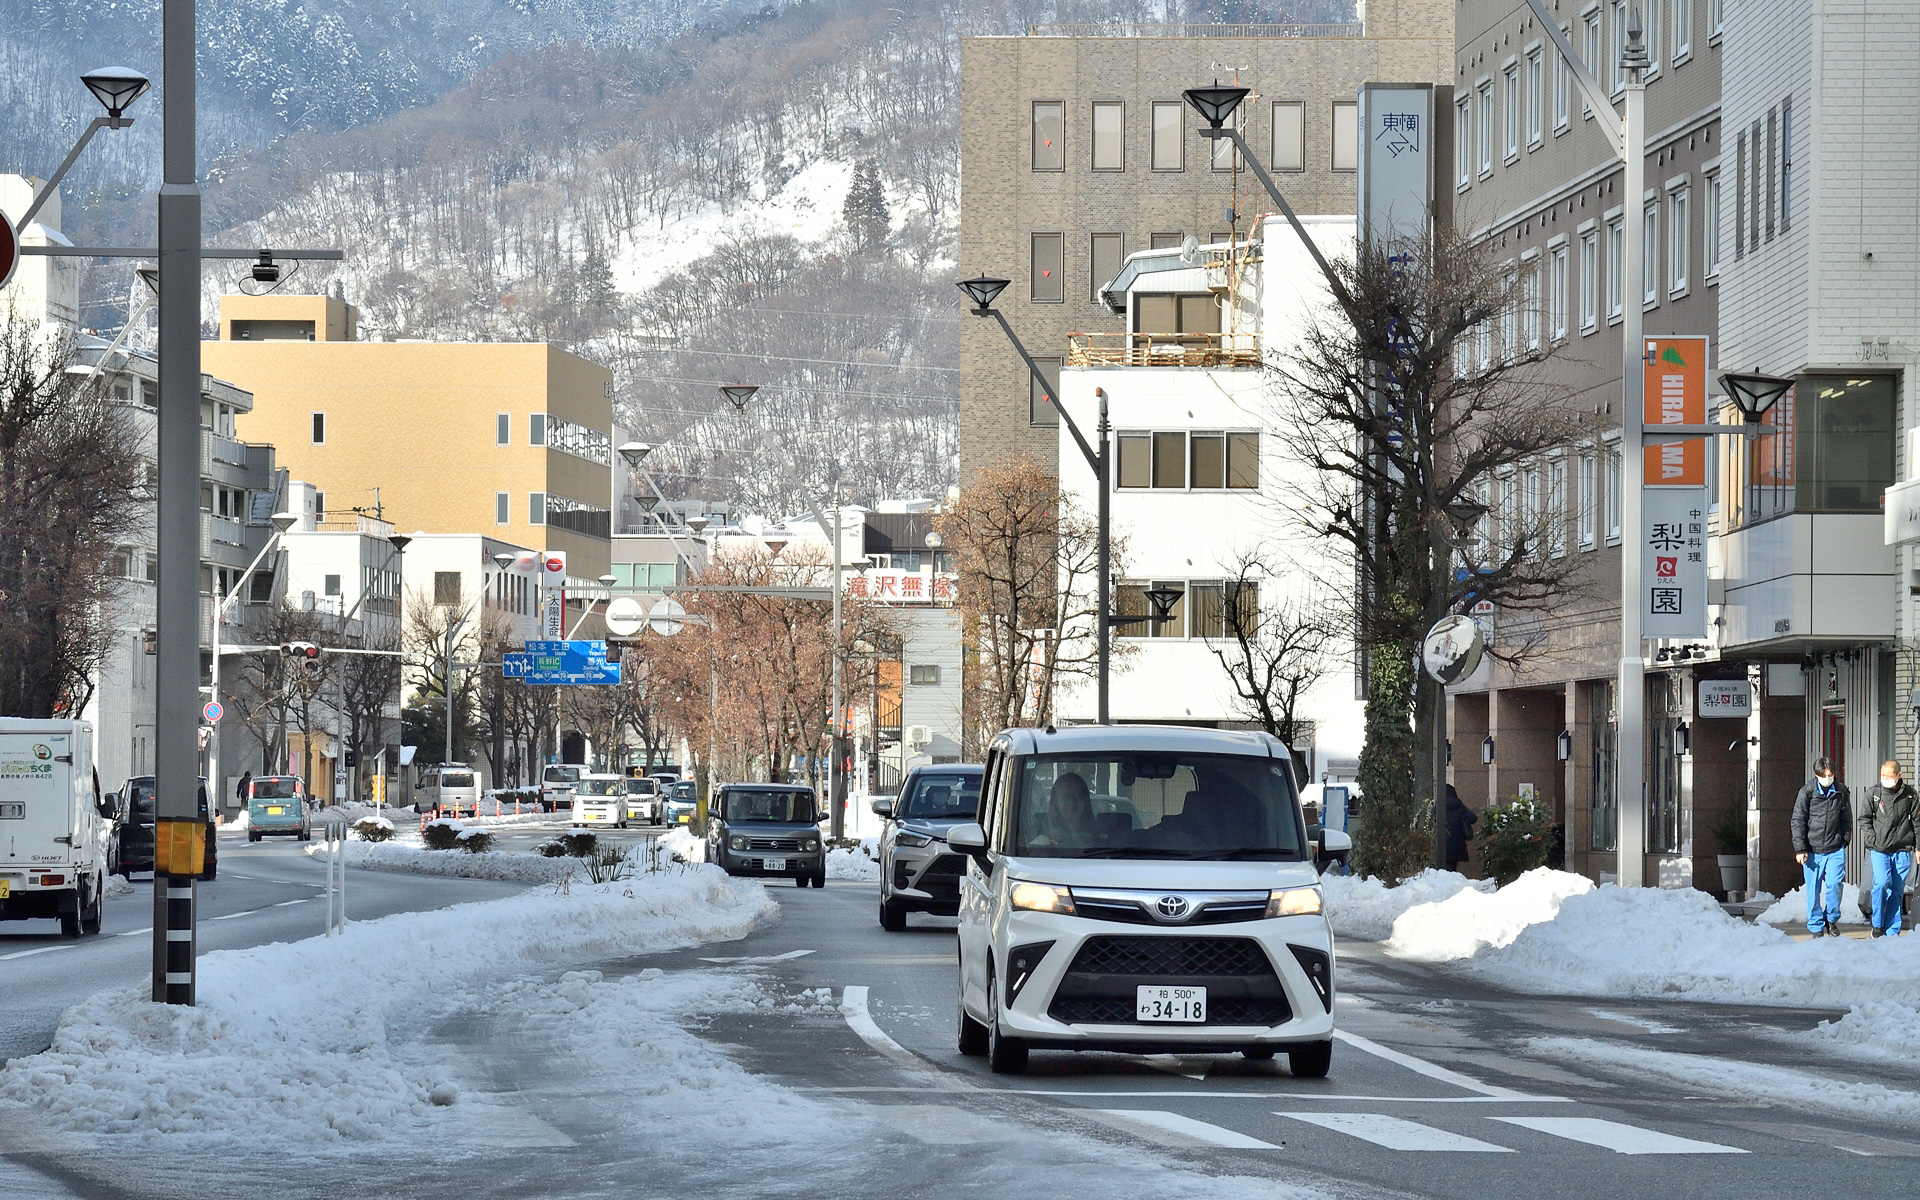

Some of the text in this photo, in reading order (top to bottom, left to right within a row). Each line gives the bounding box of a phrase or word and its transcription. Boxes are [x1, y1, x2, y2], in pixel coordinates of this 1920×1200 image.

[1687, 508, 1702, 563] 中国料理
[845, 575, 951, 598] 滝沢無線
[528, 642, 546, 650] 松本
[551, 642, 570, 650] 上田
[1159, 989, 1192, 999] 柏 500
[1140, 1000, 1203, 1019] わ 34-18
